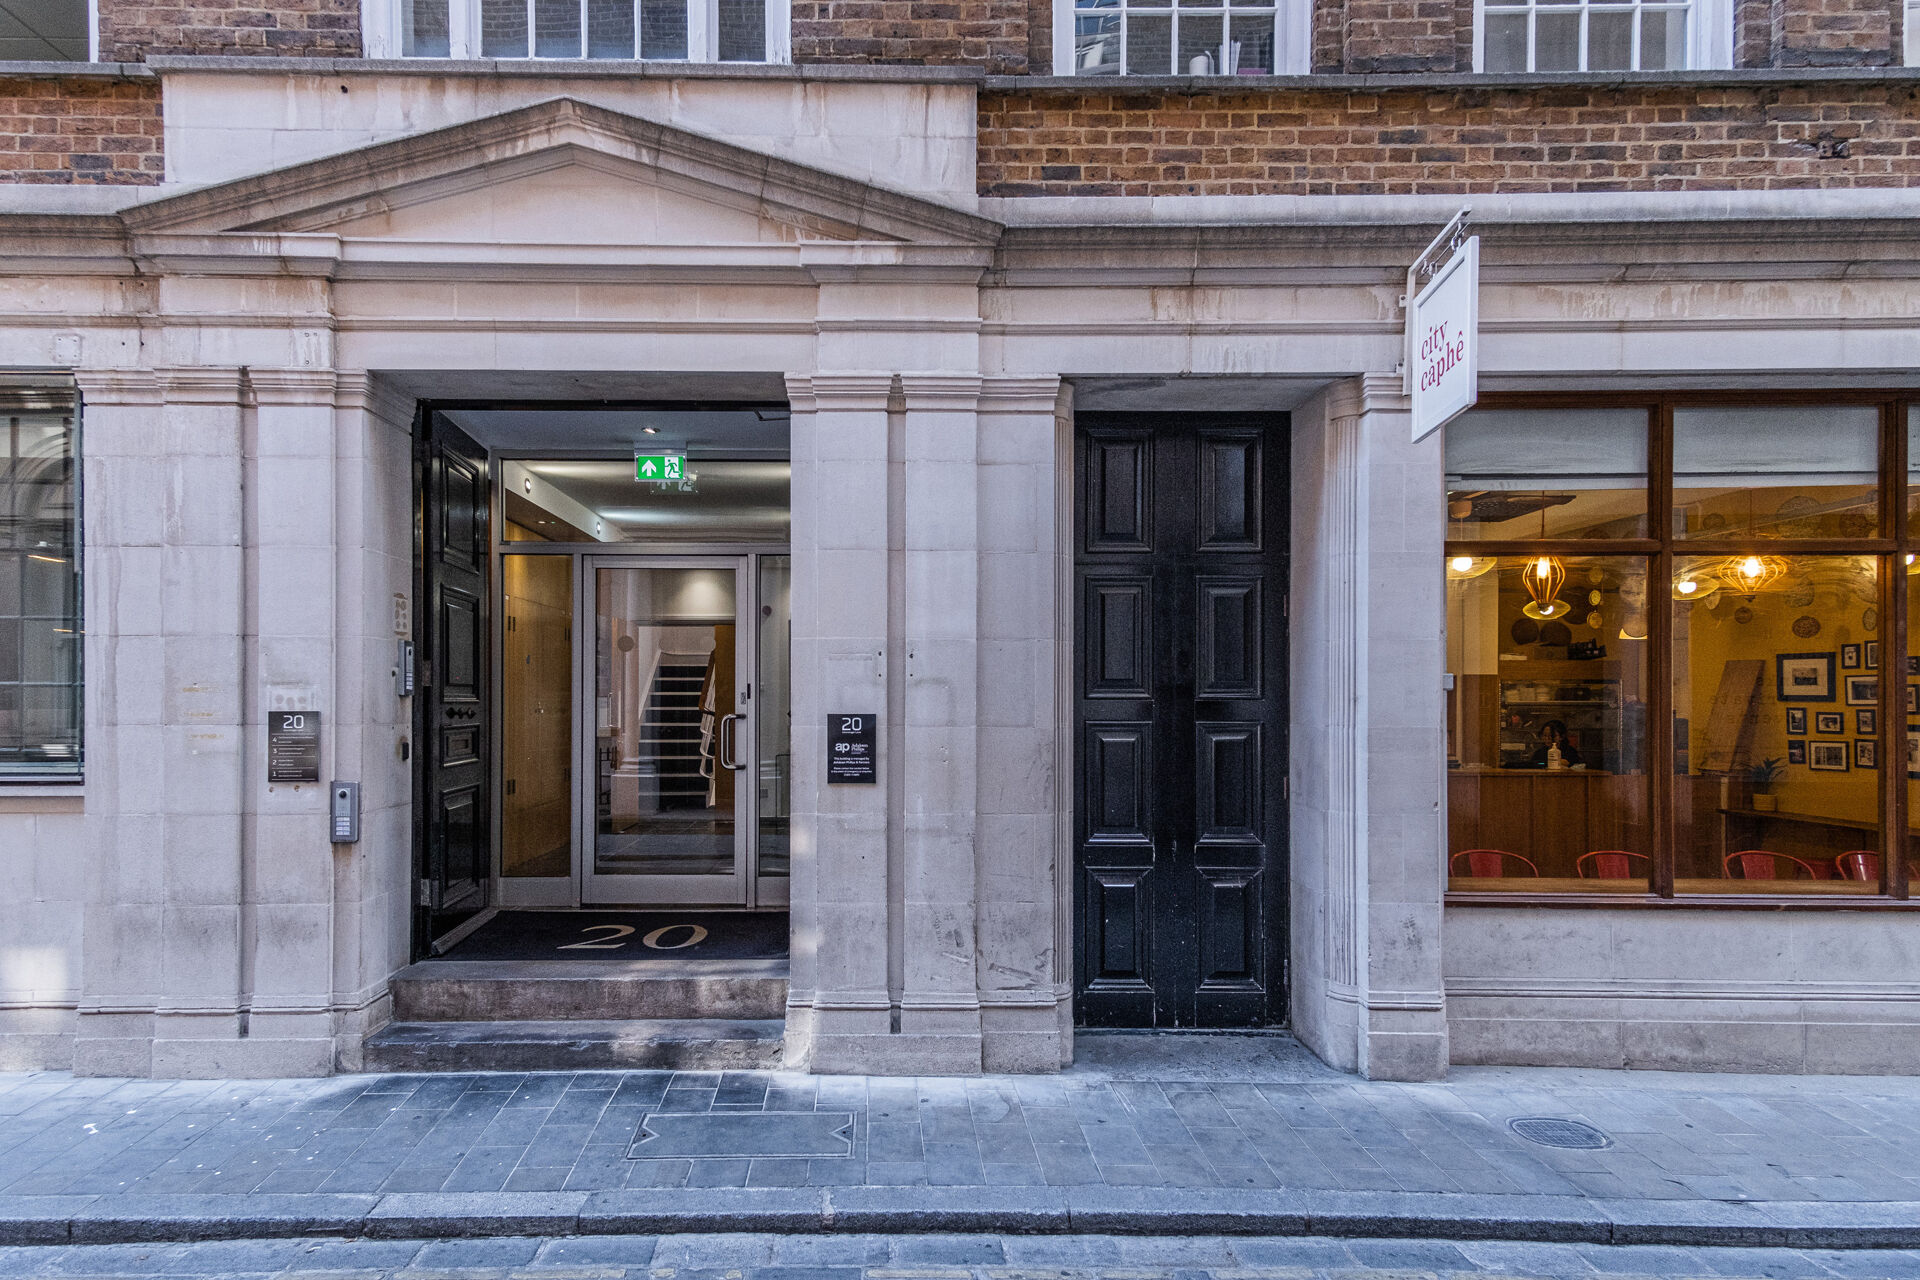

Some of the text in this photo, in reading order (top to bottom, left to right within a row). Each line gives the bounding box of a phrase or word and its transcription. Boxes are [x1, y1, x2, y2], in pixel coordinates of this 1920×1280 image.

[1421, 320, 1448, 361] city
[1420, 330, 1464, 392] càphê
[283, 714, 304, 729] 20
[841, 717, 862, 731] 20
[835, 742, 850, 753] ap
[556, 924, 709, 950] 20
